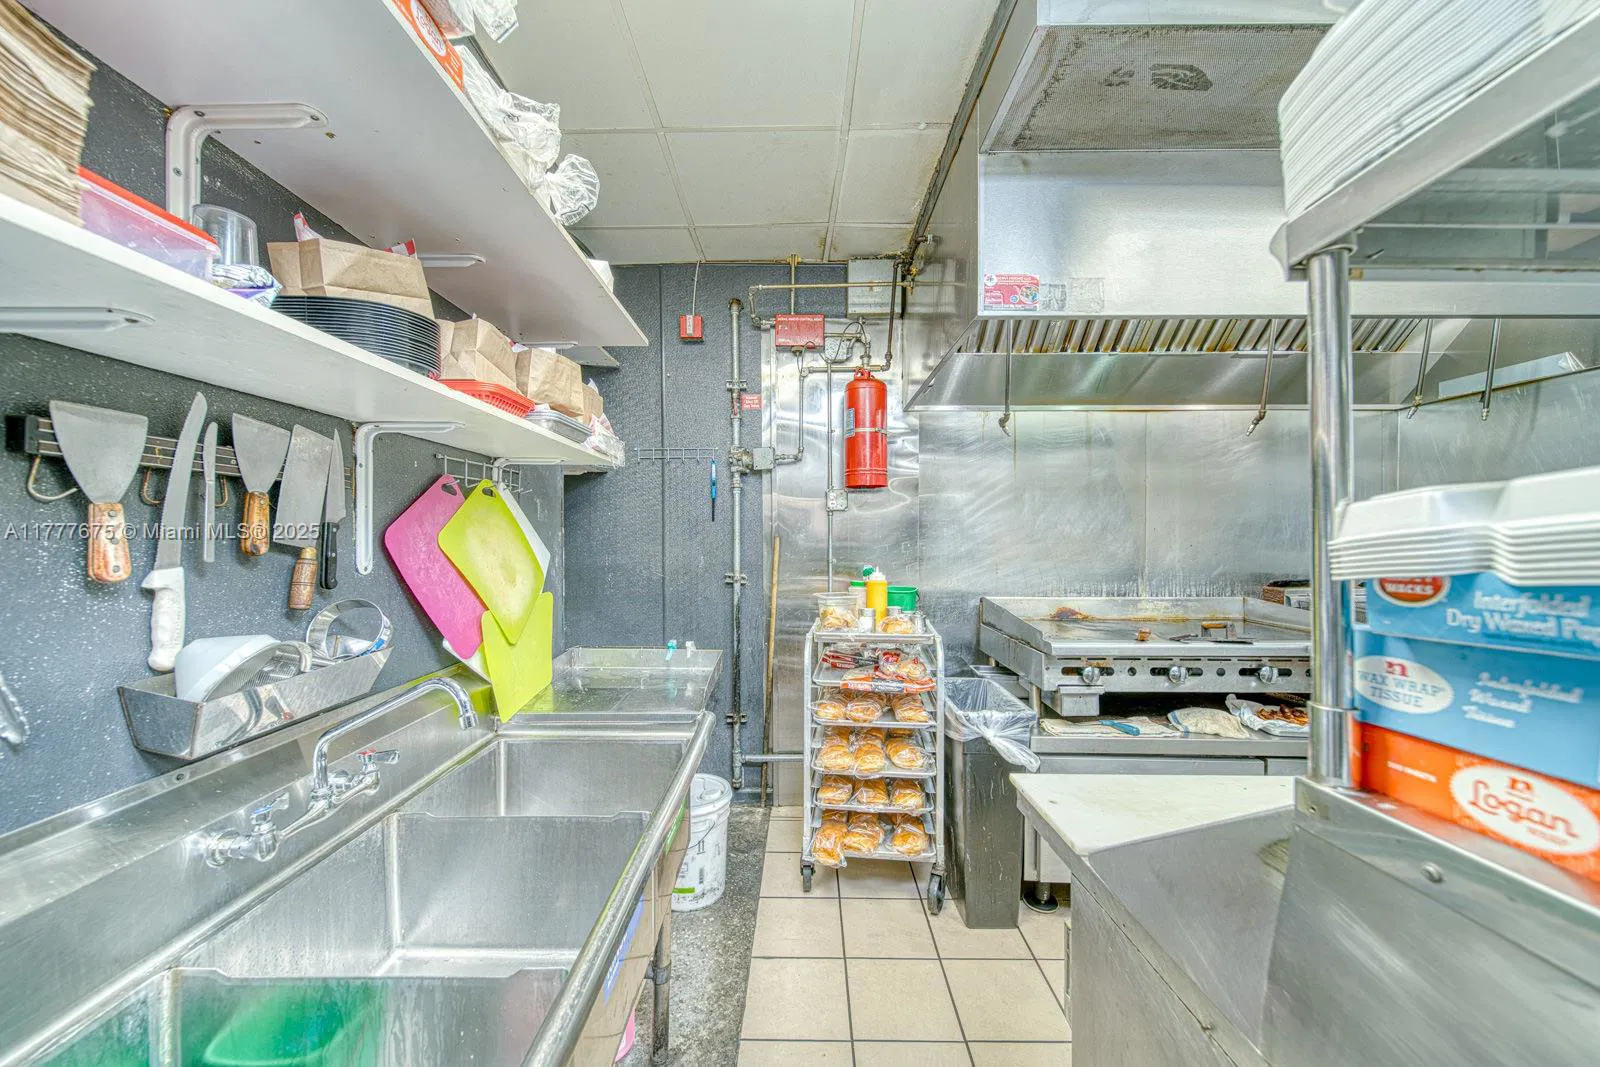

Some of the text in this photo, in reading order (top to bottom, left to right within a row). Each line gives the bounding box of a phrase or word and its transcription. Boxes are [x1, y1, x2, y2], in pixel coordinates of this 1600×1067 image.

[1474, 590, 1591, 618] Interfolded
[1446, 607, 1482, 634] Dry
[1482, 611, 1557, 637] Waxed
[1370, 685, 1425, 708] TISSUE
[1468, 779, 1581, 840] Logan
